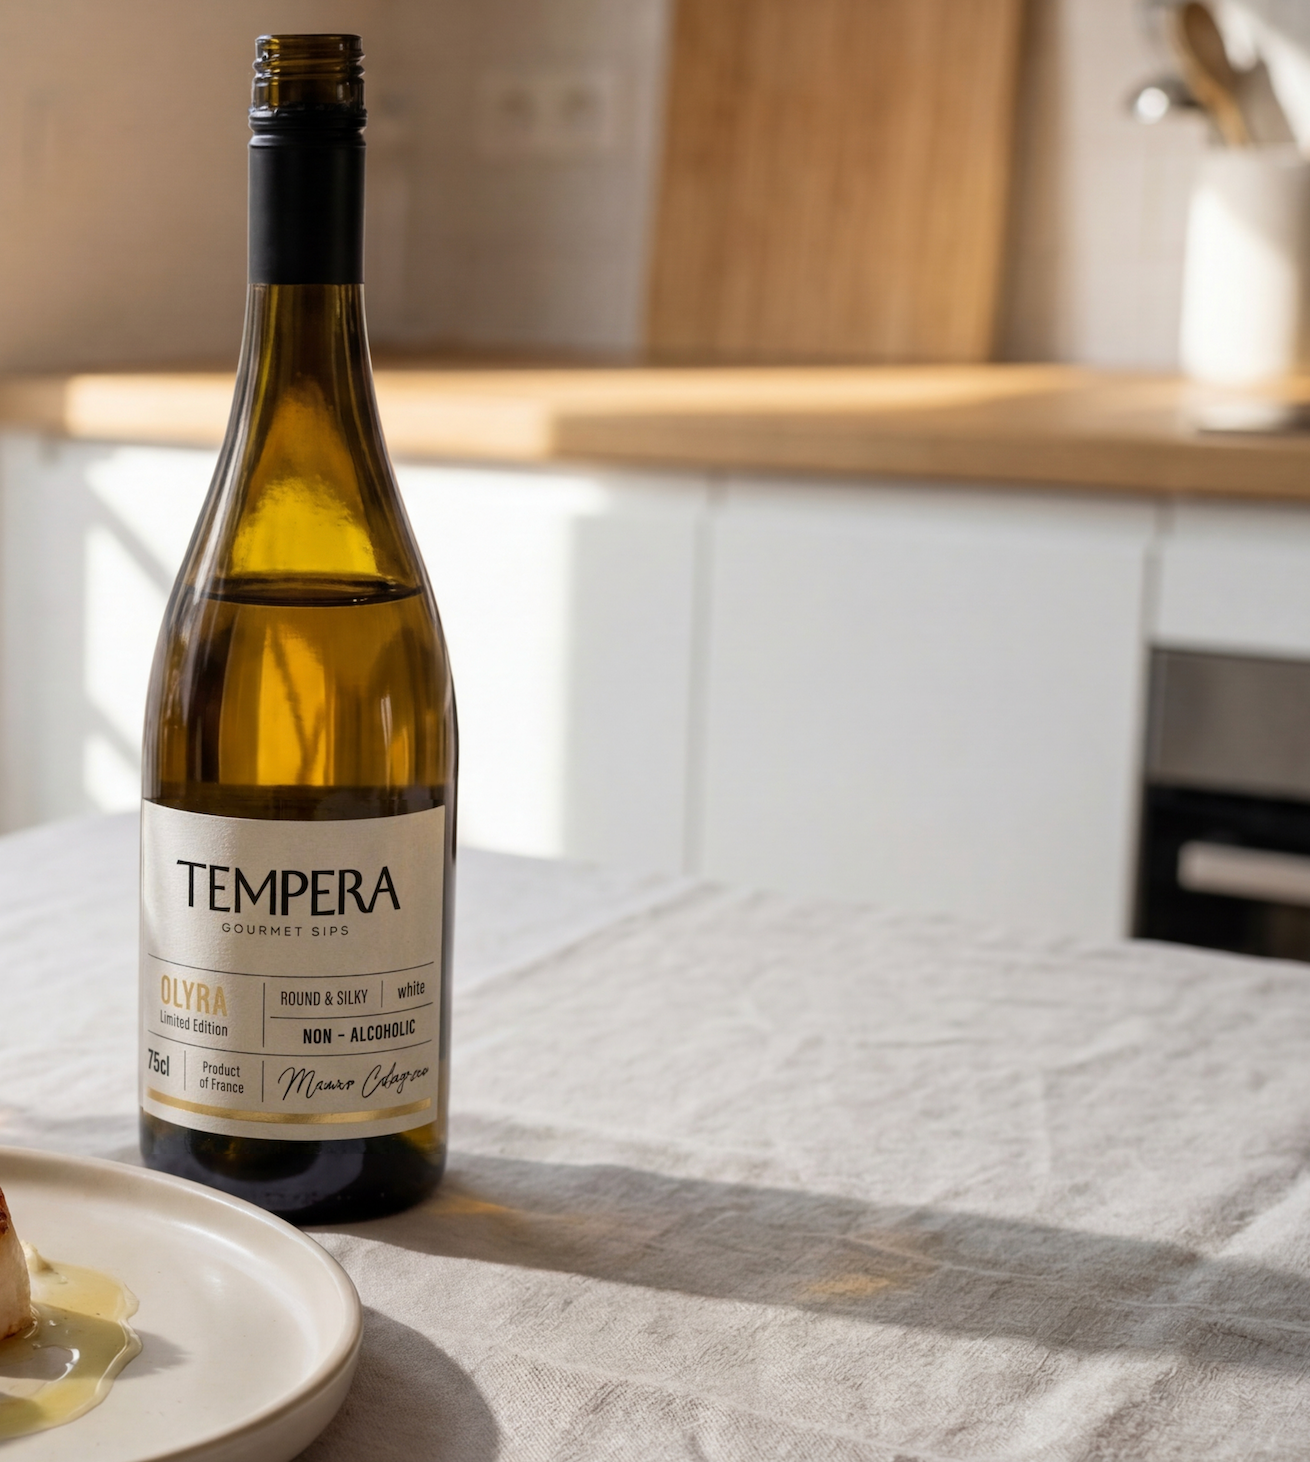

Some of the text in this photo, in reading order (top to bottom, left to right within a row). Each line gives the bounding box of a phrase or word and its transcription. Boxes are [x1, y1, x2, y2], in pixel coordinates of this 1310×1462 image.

[177, 859, 400, 916] TEMPERA
[221, 922, 349, 937] GOURMET SIPS
[160, 974, 228, 1017] OLYRA
[280, 989, 368, 1006] ROUND & SILKY
[398, 980, 425, 999] white
[160, 1010, 228, 1037] Limited Edition
[303, 1028, 332, 1044] NON
[350, 1019, 416, 1043] ALCOHOLIC
[148, 1049, 170, 1077] 75cl
[202, 1060, 241, 1078] Product
[199, 1077, 244, 1094] of France
